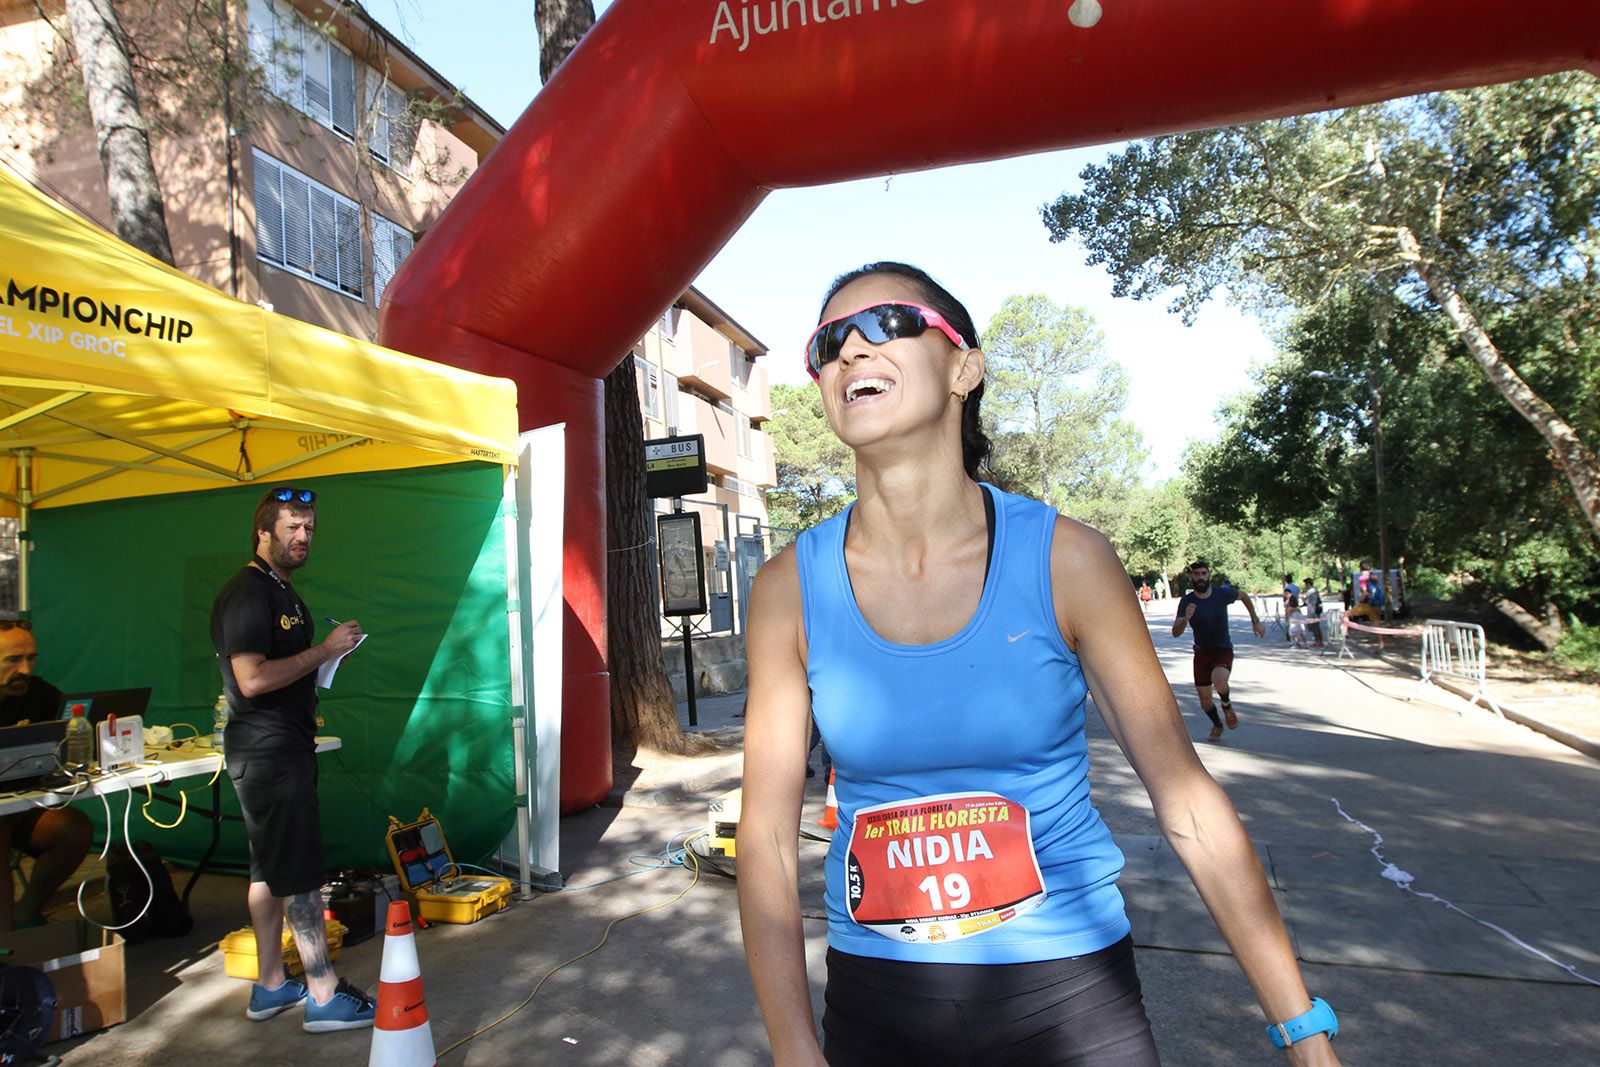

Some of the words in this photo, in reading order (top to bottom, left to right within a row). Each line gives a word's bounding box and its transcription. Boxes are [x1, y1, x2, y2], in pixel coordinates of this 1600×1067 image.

[709, 0, 924, 52] Ajunta
[27, 321, 64, 344] XIP
[70, 331, 127, 358] GROC
[671, 442, 692, 453] BUS
[864, 823, 885, 839] 1er
[886, 815, 926, 837] TRAIL
[930, 806, 1009, 831] FLORESTA
[882, 812, 899, 821] CURSA
[900, 809, 909, 818] DE
[910, 808, 919, 817] LA
[920, 803, 953, 815] FLORESTA
[886, 830, 994, 869] NIDIA
[918, 873, 971, 912] 19
